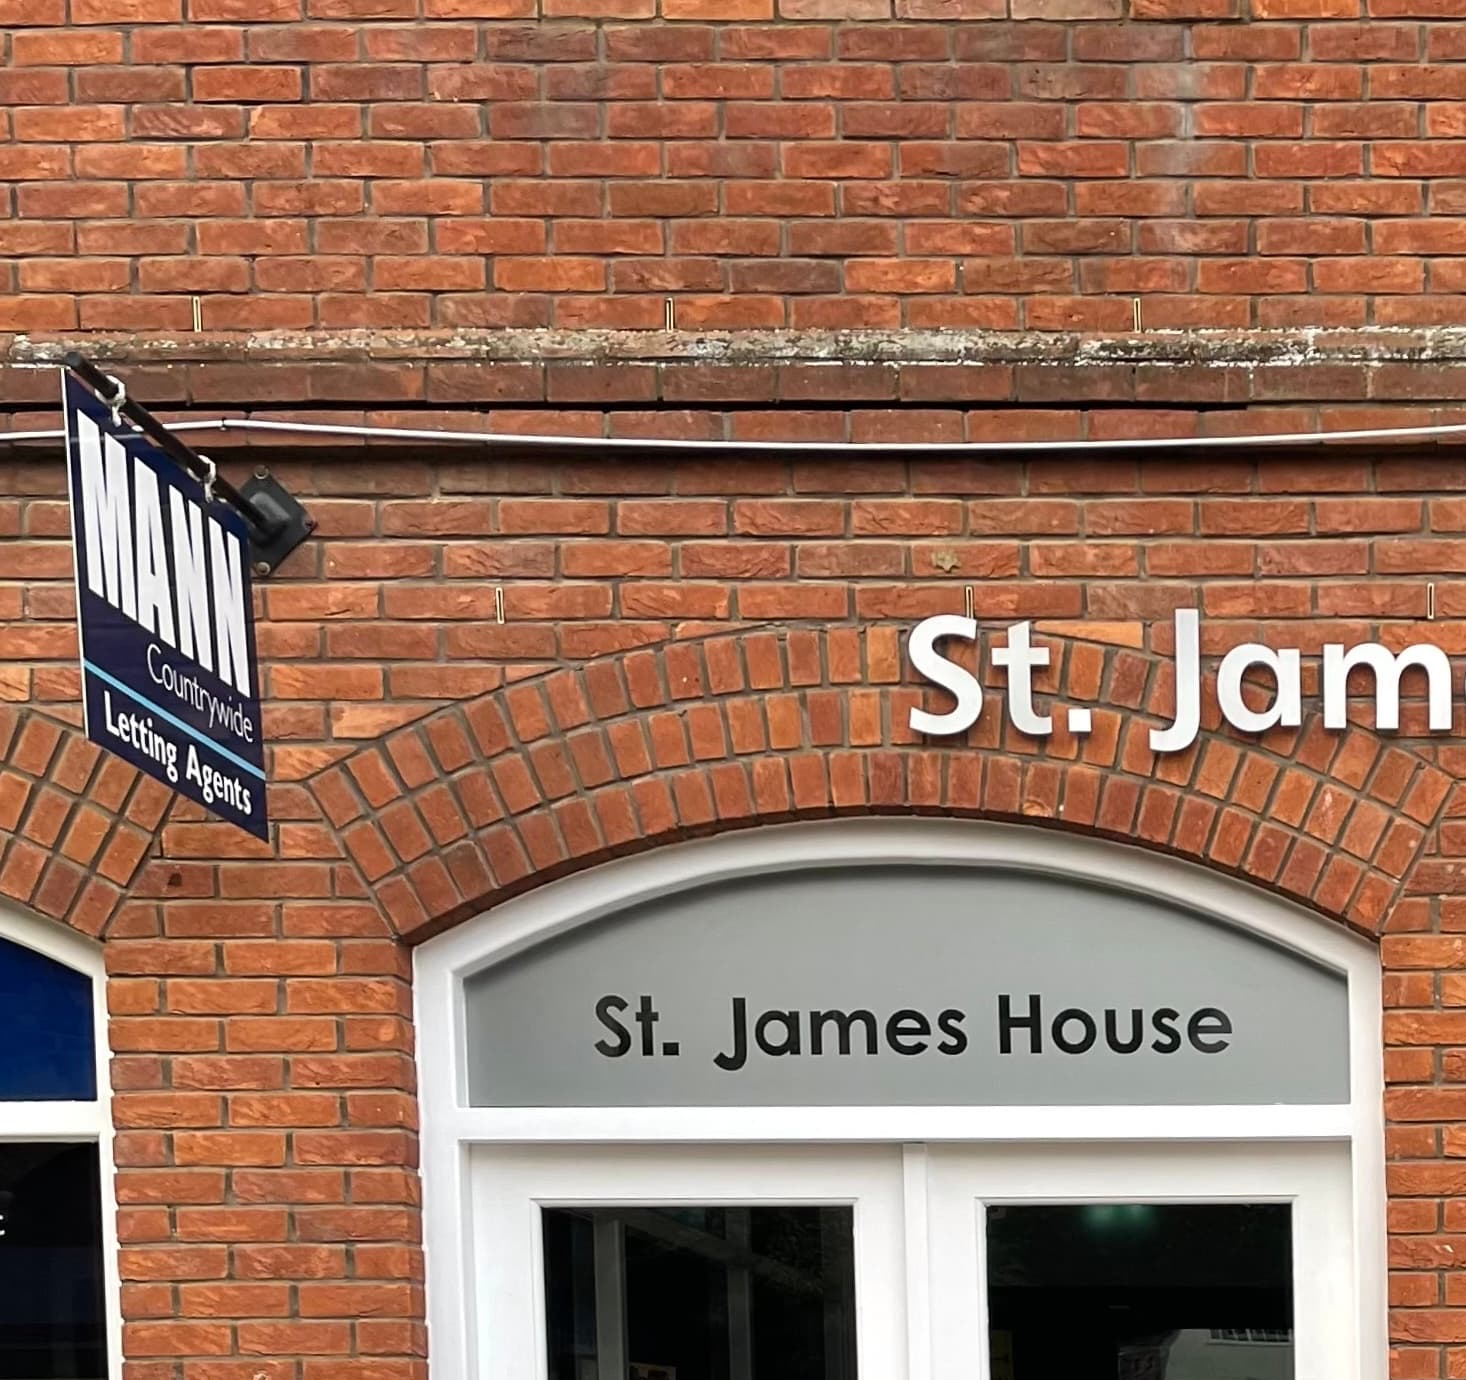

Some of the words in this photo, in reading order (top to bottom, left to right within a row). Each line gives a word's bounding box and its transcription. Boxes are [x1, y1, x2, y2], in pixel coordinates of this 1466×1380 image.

[77, 409, 250, 697] MANN
[147, 643, 253, 743] Countrywide
[908, 614, 1092, 736] St.
[104, 690, 178, 783] Letting
[185, 744, 252, 816] Agents
[594, 995, 680, 1058] St.
[712, 996, 968, 1072] James
[998, 993, 1233, 1056] House
